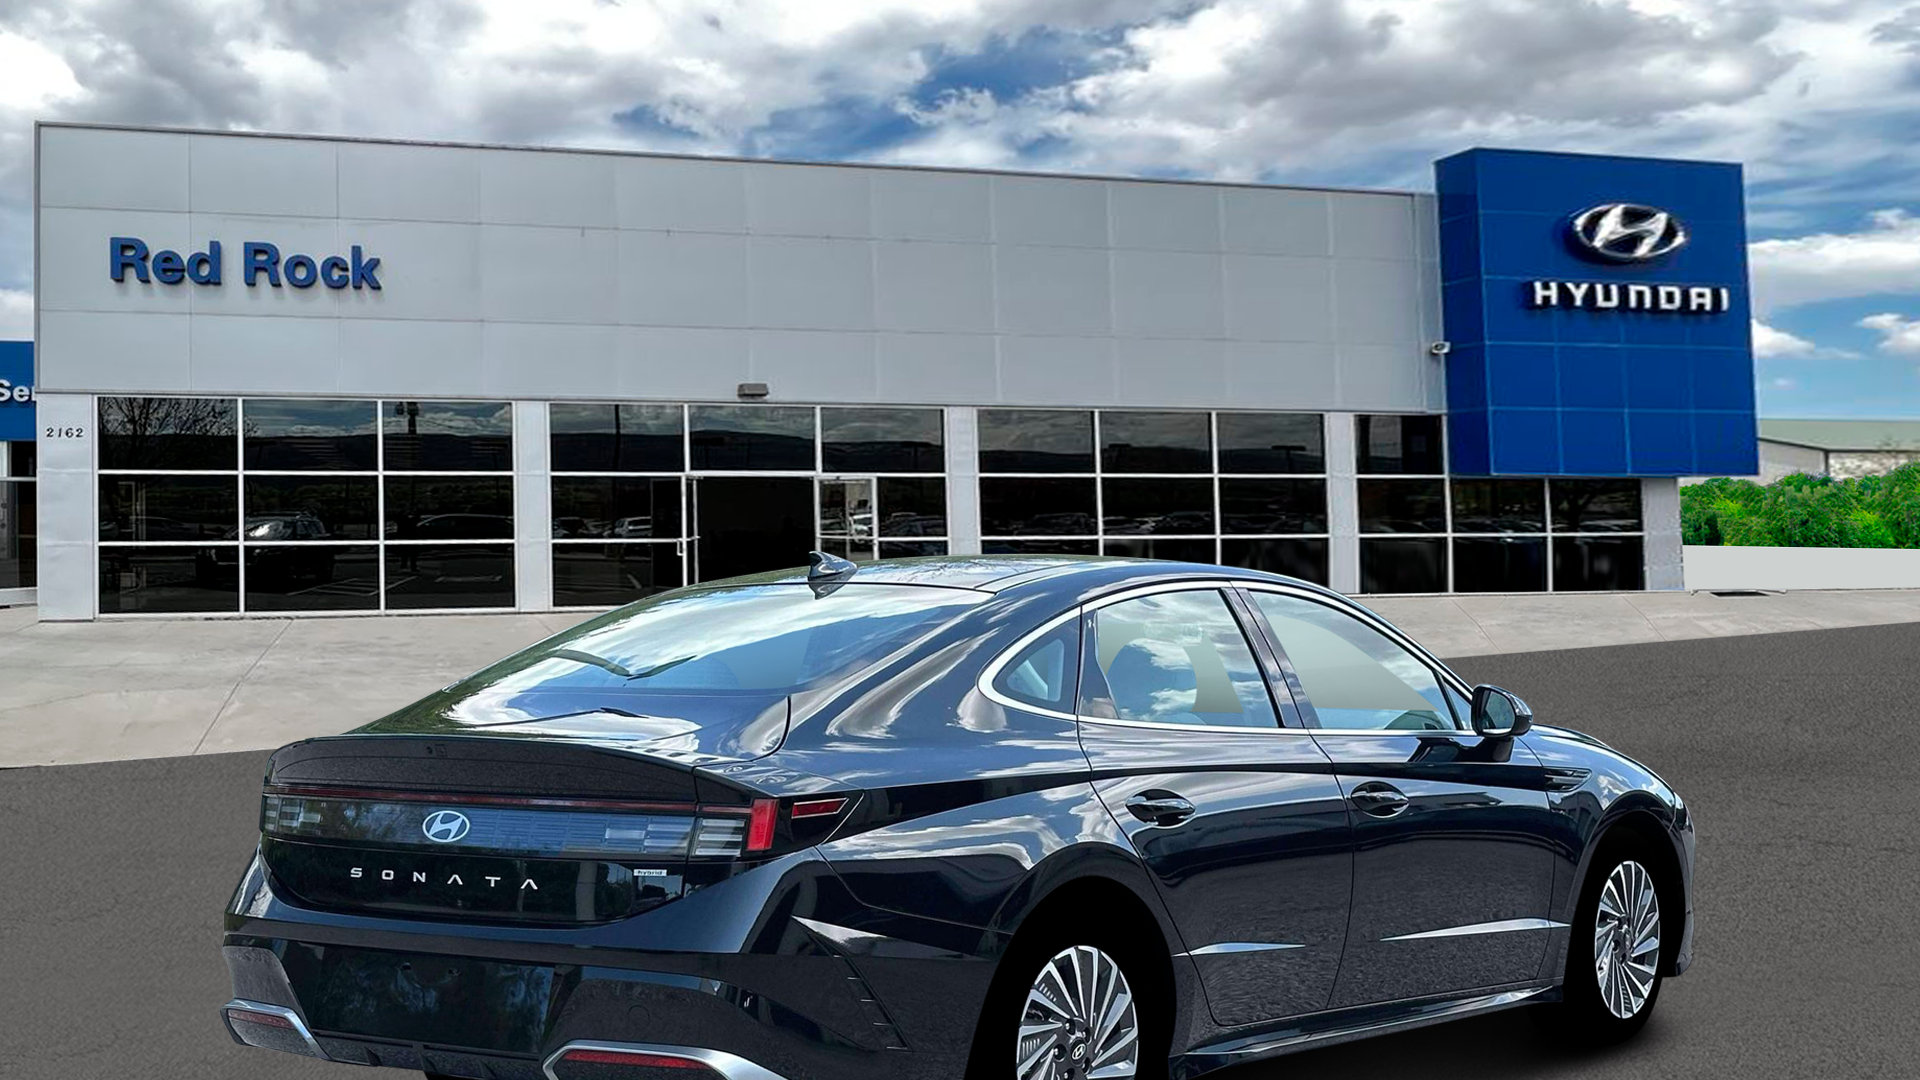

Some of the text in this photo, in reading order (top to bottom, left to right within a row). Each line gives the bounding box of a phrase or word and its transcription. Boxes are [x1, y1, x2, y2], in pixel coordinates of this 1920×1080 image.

[110, 236, 382, 290] Red Rock
[1533, 280, 1729, 312] HYUNDAI
[46, 427, 84, 438] 2162
[350, 866, 539, 891] SONATA
